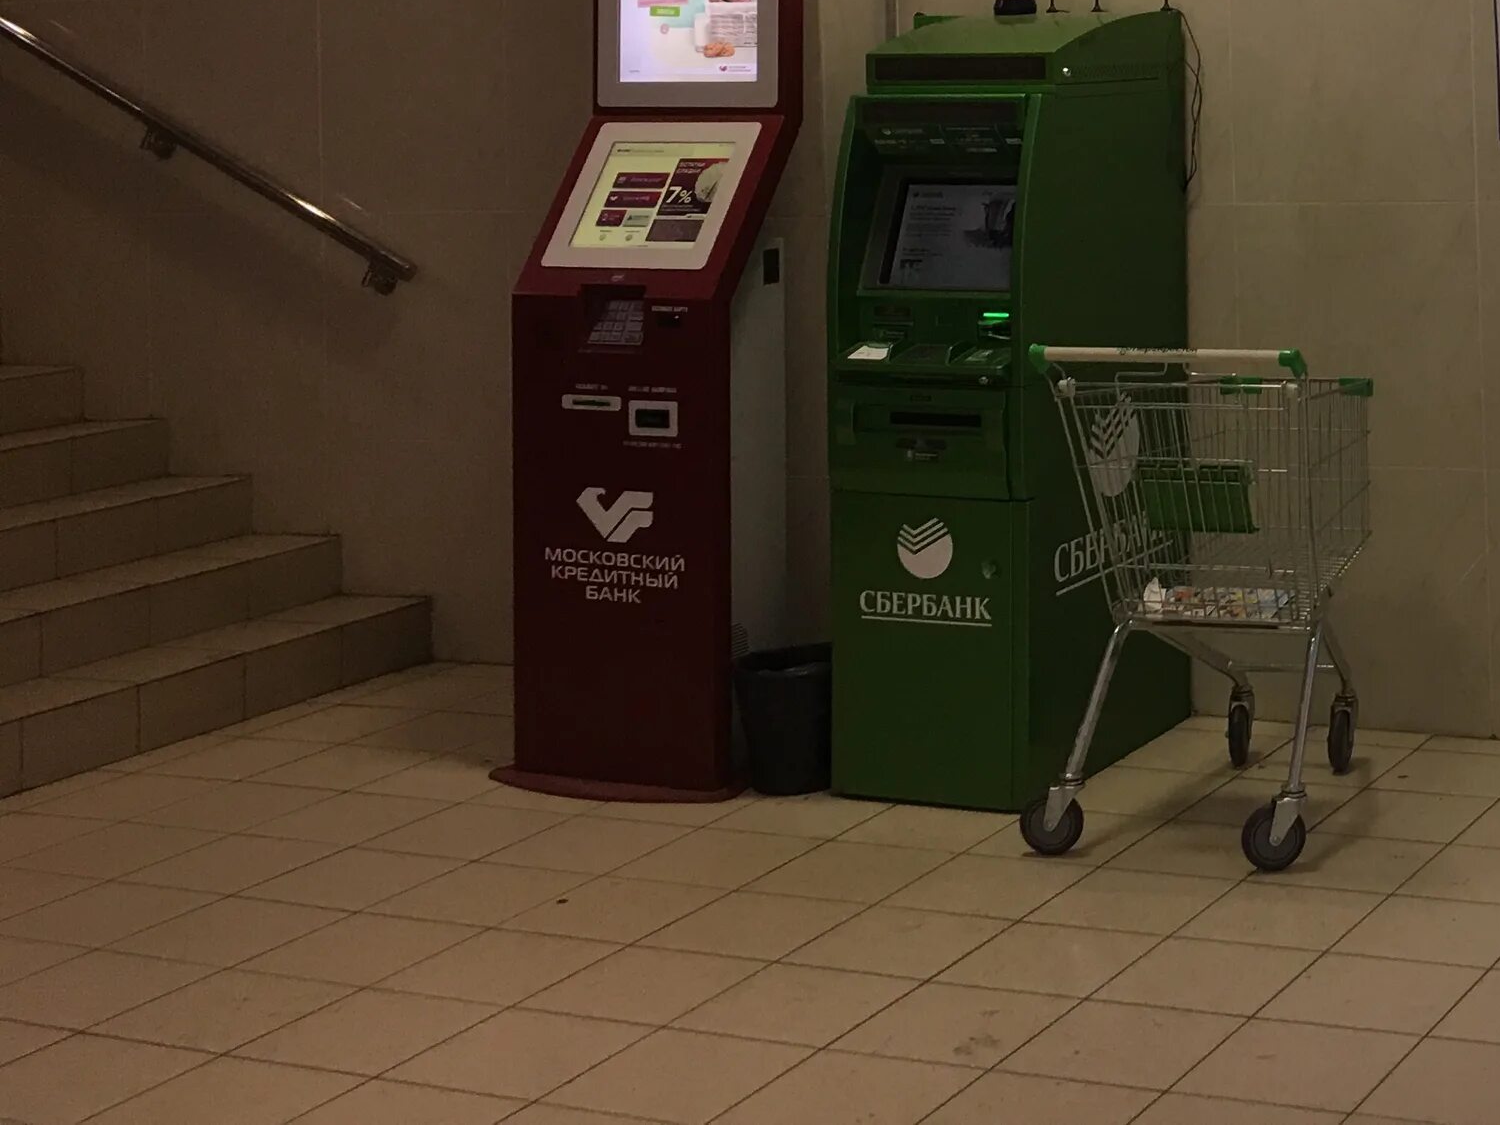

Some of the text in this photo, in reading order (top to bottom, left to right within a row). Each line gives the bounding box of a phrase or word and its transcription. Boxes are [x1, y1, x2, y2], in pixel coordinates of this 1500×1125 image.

[666, 186, 692, 204] 7%
[545, 547, 685, 572] МОСКОВСКИЙ
[551, 564, 679, 589] КРЕДИТНЫЙ
[585, 585, 641, 603] БАНК
[859, 590, 992, 620] СБЕРБАНК
